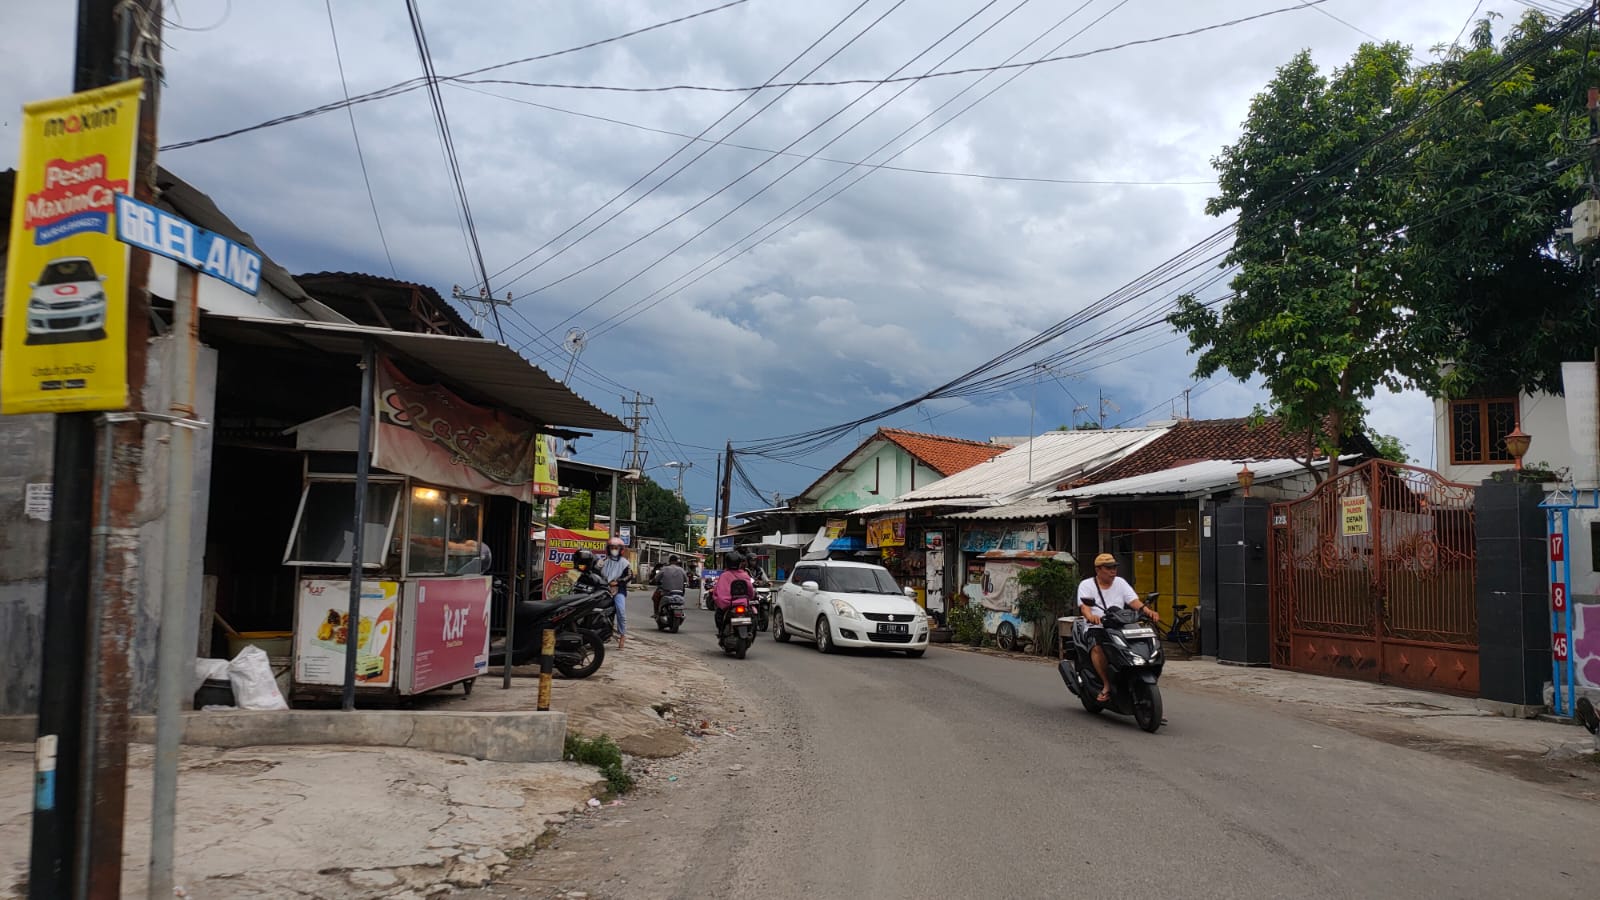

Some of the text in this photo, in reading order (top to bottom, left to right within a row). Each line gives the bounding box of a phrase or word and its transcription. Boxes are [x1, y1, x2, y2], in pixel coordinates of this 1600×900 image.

[47, 162, 103, 189] Pesan
[1552, 537, 1562, 555] 17
[1555, 587, 1563, 607] 8
[1554, 637, 1567, 656] 45
